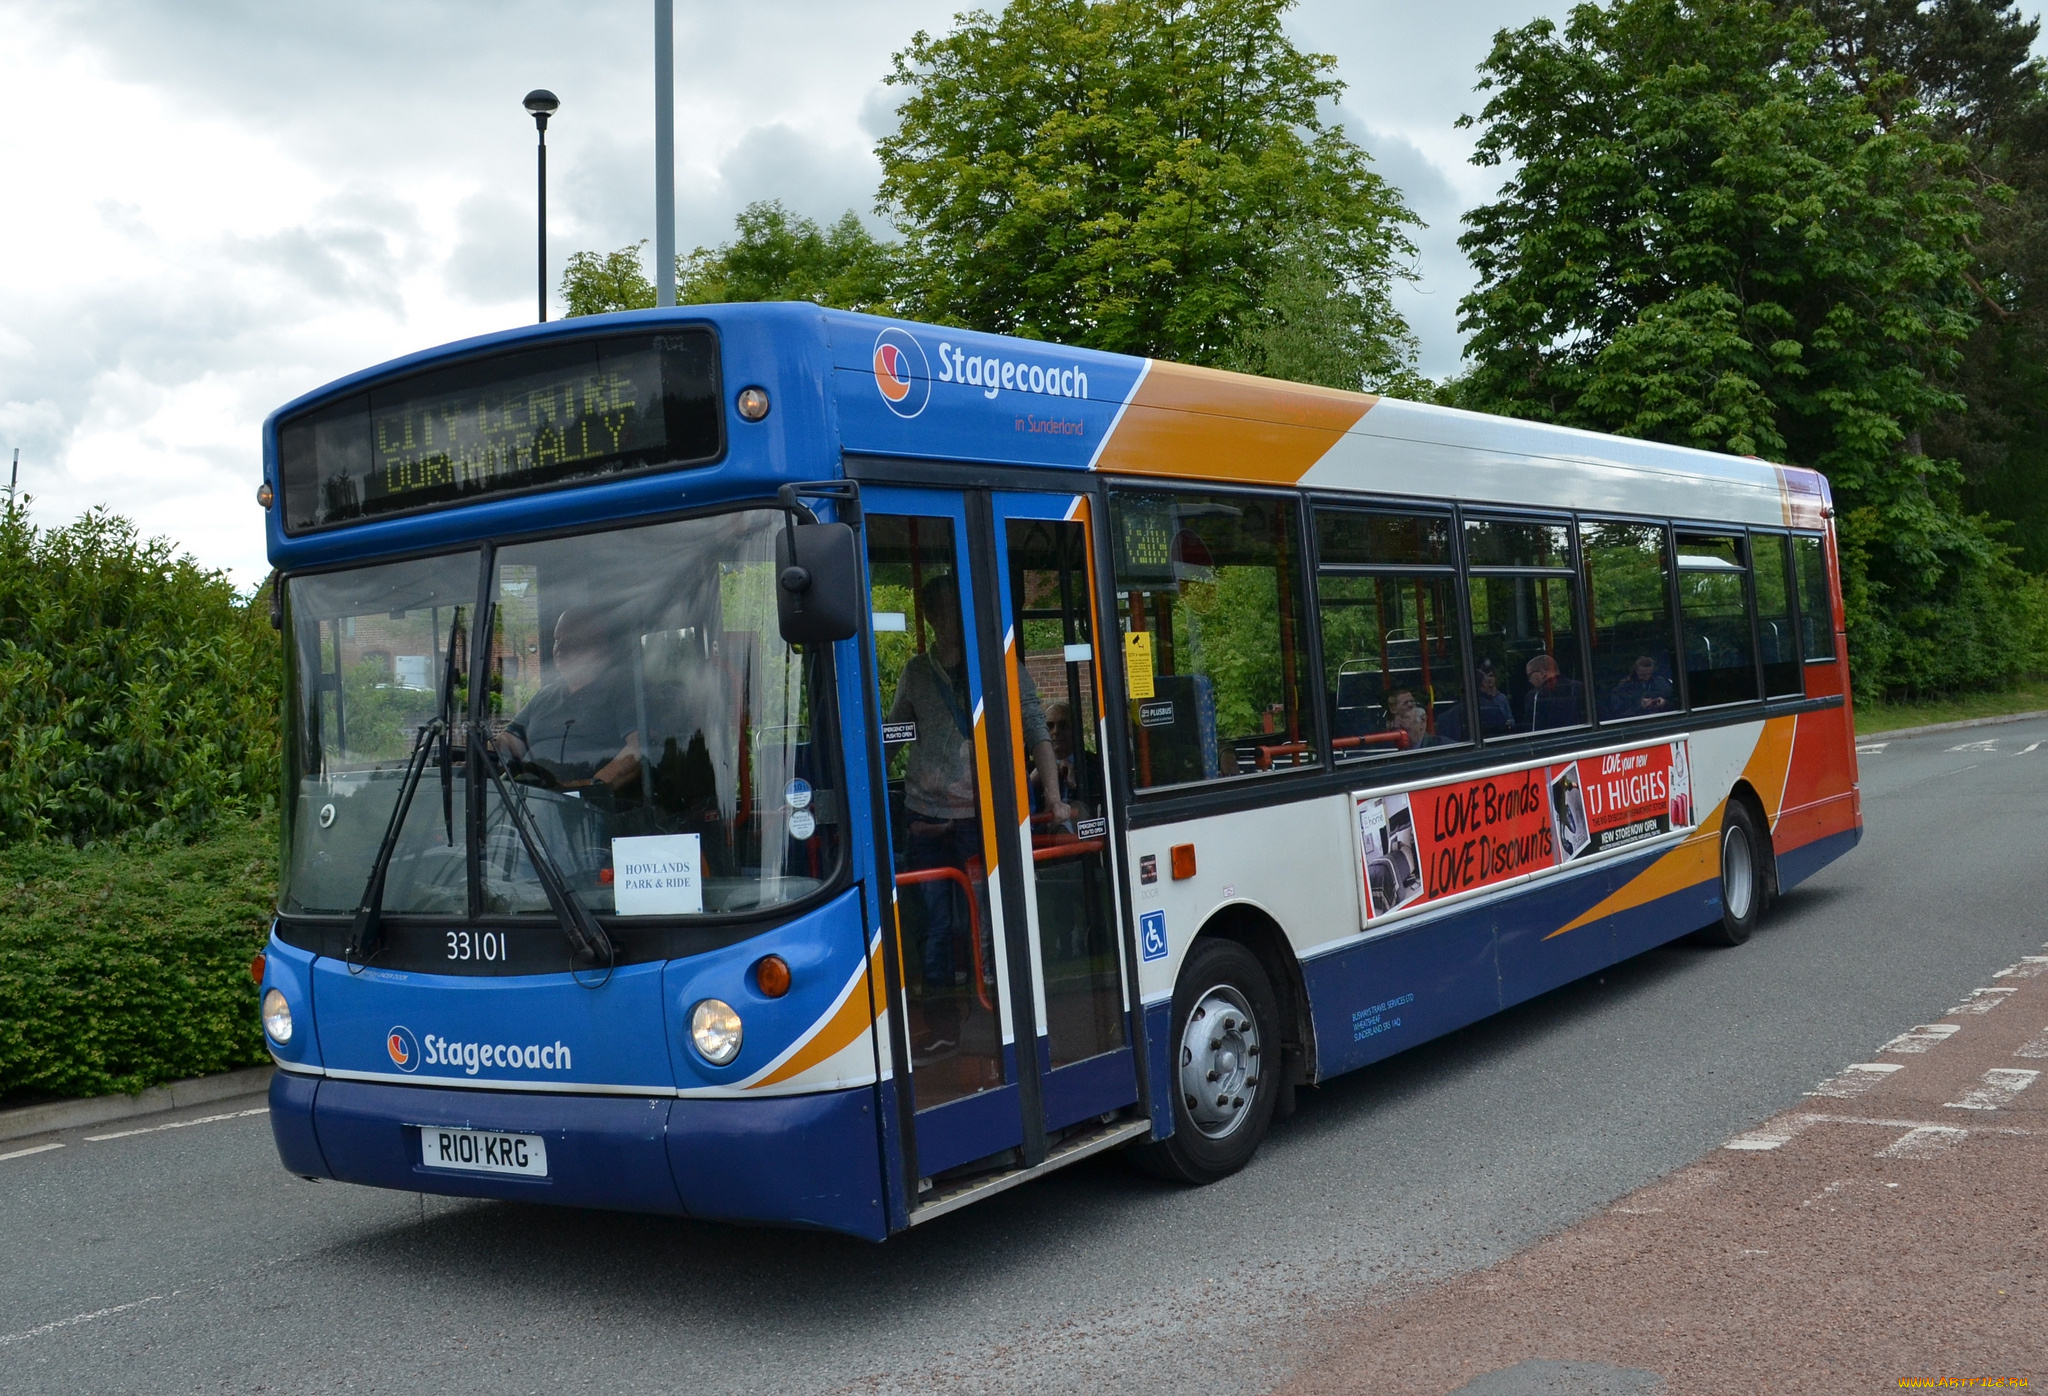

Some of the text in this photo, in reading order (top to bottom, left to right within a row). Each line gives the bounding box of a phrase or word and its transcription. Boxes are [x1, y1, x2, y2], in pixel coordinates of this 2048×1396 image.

[938, 342, 1088, 399] Stagecoach
[1015, 414, 1084, 435] in Sunderland
[387, 413, 625, 493] DURHAM RALLY
[1602, 753, 1648, 776] LOVE your new
[1434, 770, 1540, 842] LOVE Brands
[1587, 770, 1666, 815] TJ HUGHES
[1653, 801, 1667, 811] STORE
[1601, 831, 1614, 844] NEW
[1615, 826, 1630, 841] STORE
[1630, 822, 1644, 836] NOW
[1644, 819, 1658, 832] OPEN
[625, 862, 690, 874] HOWLANDS
[1428, 816, 1553, 899] LOVE Discounts
[625, 878, 691, 889] PARK & RIDE
[446, 931, 506, 961] 33101
[1354, 1024, 1383, 1042] SUNDERLAND
[424, 1034, 572, 1075] Stagecoach
[439, 1133, 529, 1168] R101 KRG
